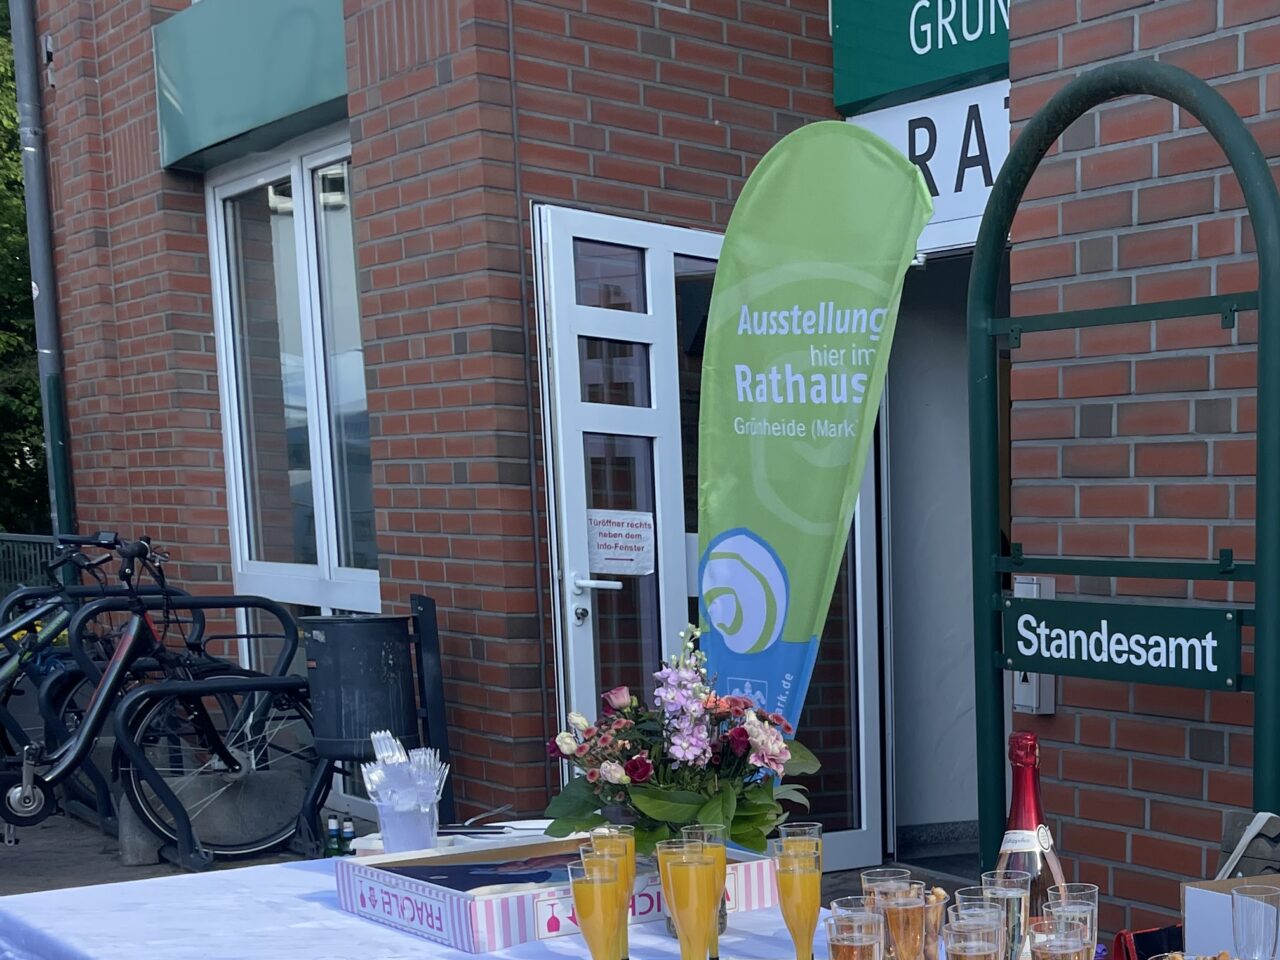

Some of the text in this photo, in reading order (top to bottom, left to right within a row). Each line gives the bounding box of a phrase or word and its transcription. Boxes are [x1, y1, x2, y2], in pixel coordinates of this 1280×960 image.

[908, 96, 1010, 197] RA
[737, 302, 888, 341] Ausstellung
[810, 344, 845, 366] hier
[735, 363, 868, 404] Rathaus
[734, 416, 859, 440] Grünheide (Mark
[588, 518, 652, 530] Türöffner rechts
[598, 531, 622, 539] neben
[597, 542, 645, 552] Info-Fenster
[1017, 613, 1217, 672] Standesamt
[774, 673, 794, 715] ark.de
